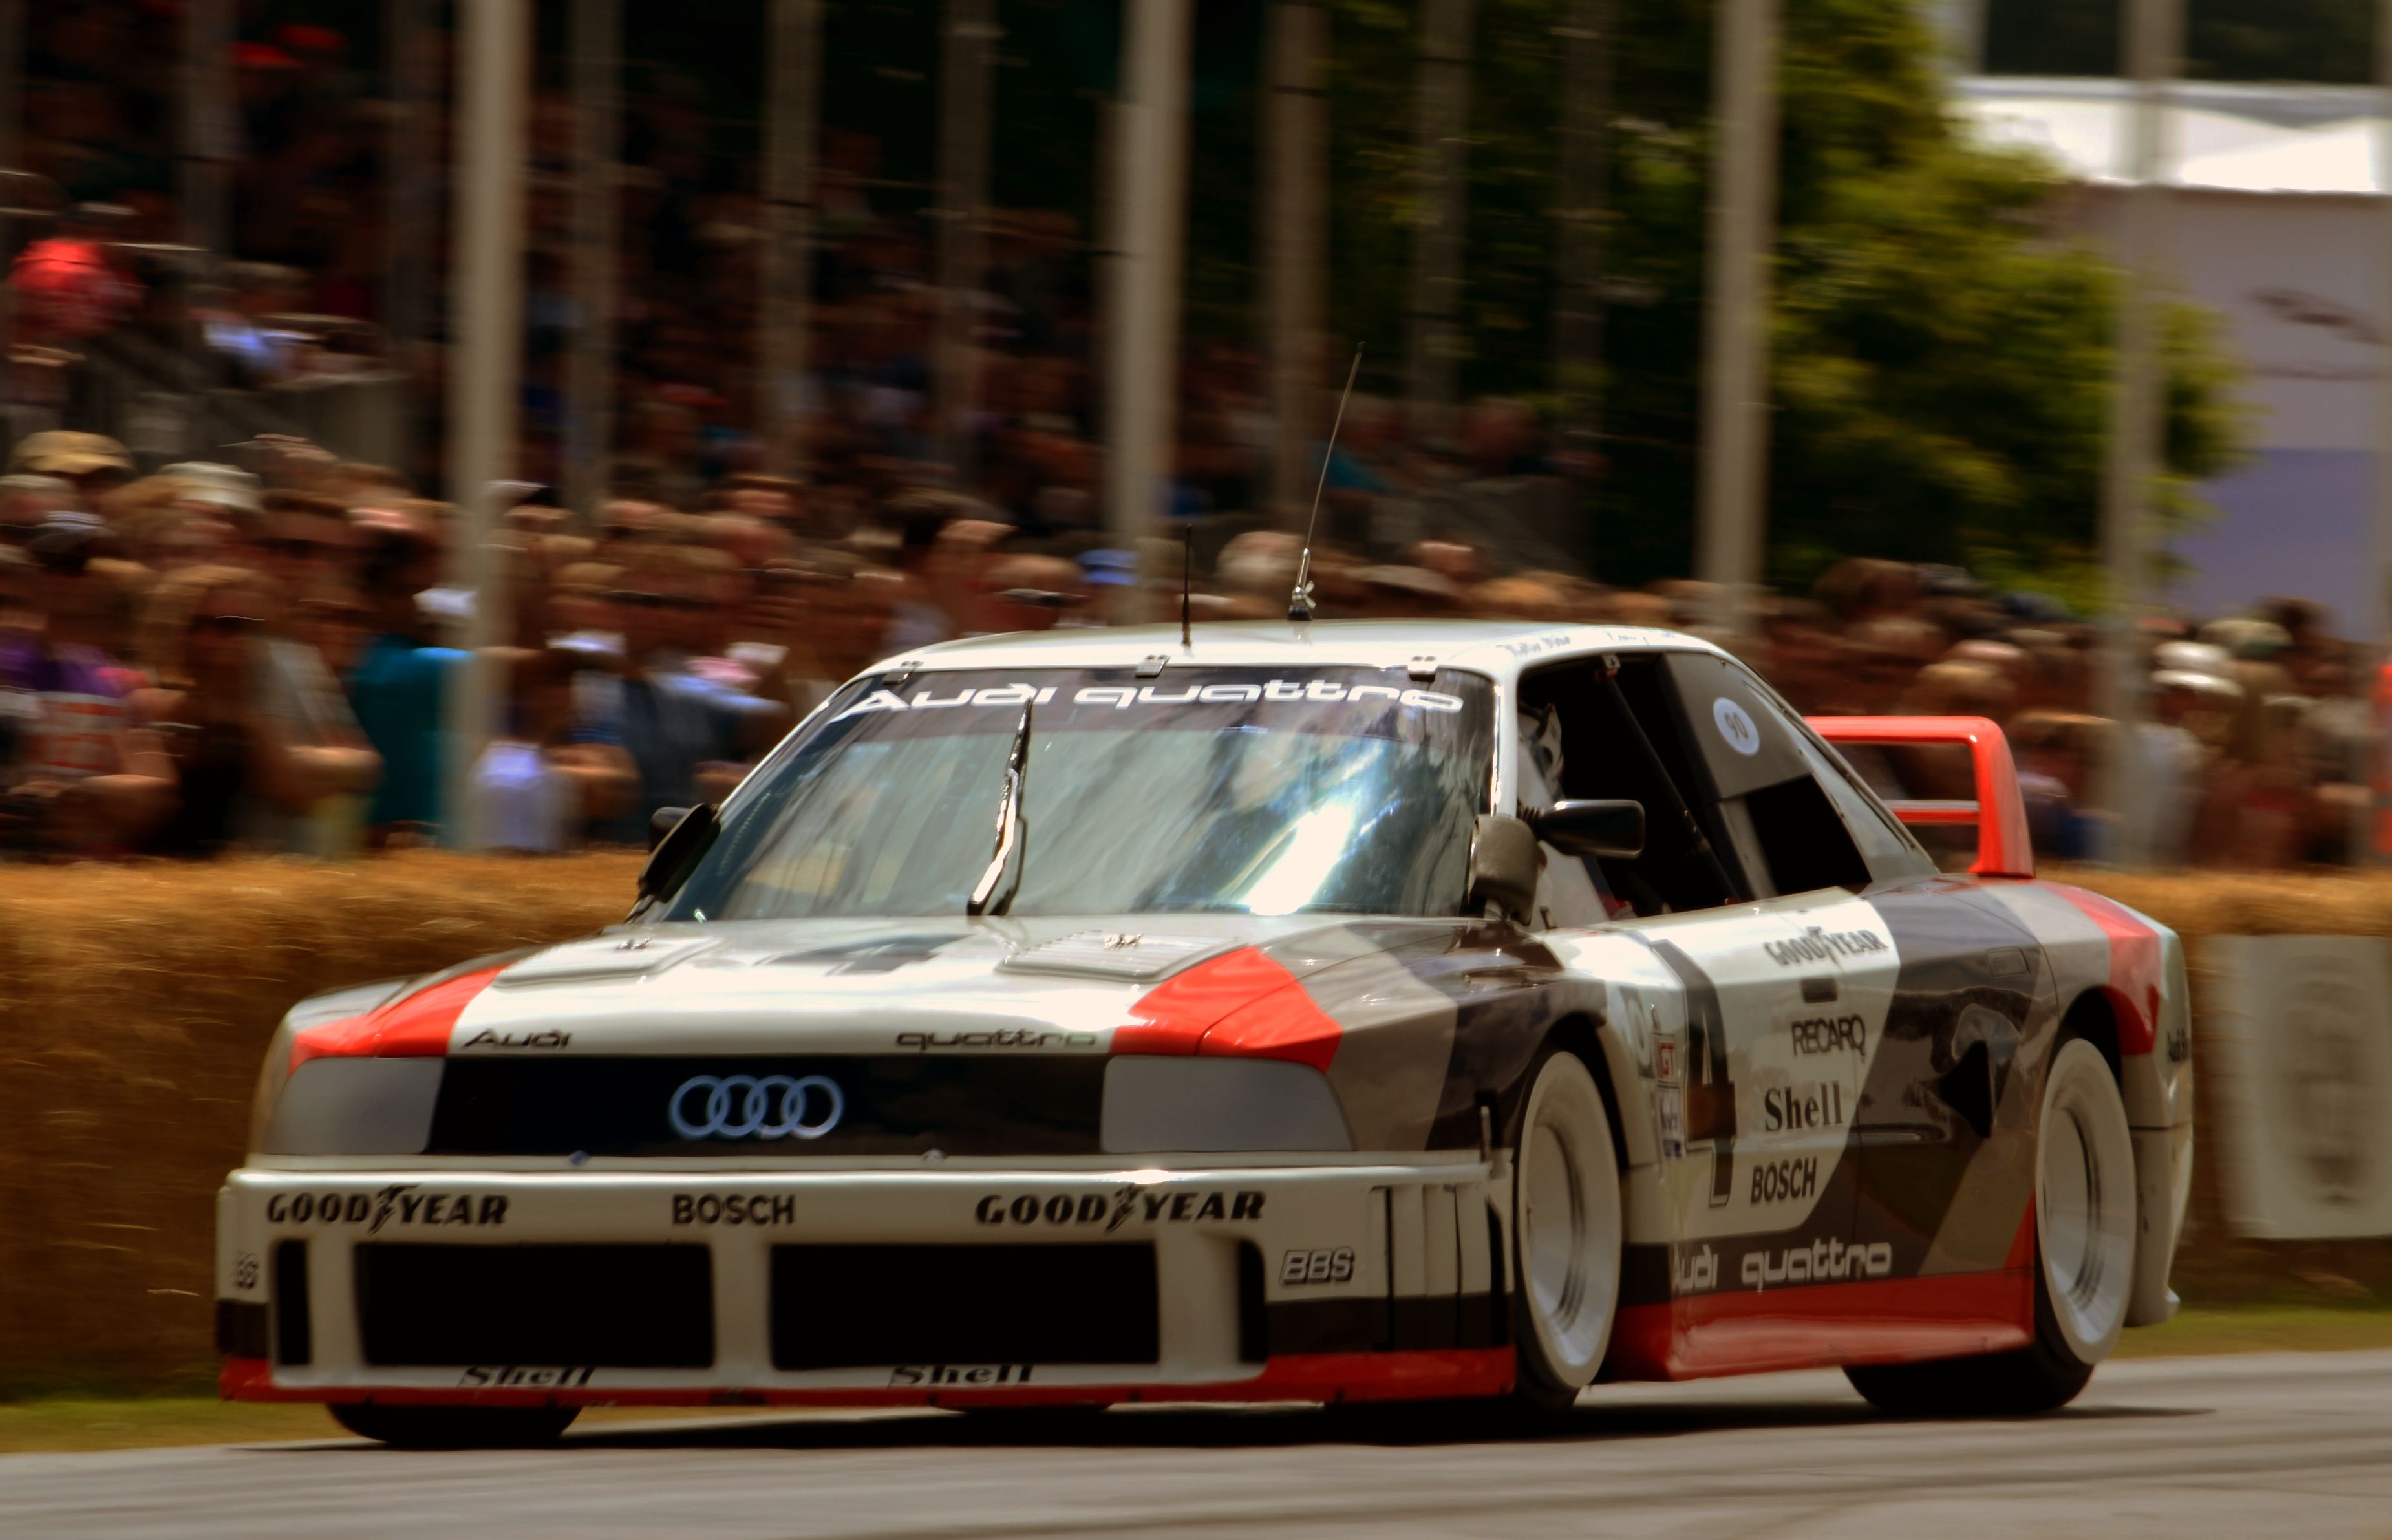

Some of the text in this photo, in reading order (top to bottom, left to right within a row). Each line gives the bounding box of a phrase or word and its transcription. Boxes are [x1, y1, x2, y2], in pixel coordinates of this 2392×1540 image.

[827, 679, 1464, 723] Audi quattro
[462, 1027, 1096, 1051] Audi quattro
[1792, 1014, 1866, 1062] RECARO
[1764, 1081, 1842, 1132] Shell
[1751, 1157, 1817, 1204] BOSCH
[673, 1194, 795, 1225] BOSCH
[1281, 1248, 1354, 1286] BBS
[1742, 1237, 1892, 1293] quattro
[459, 1365, 595, 1387] Shell
[889, 1364, 1033, 1387] Shell
